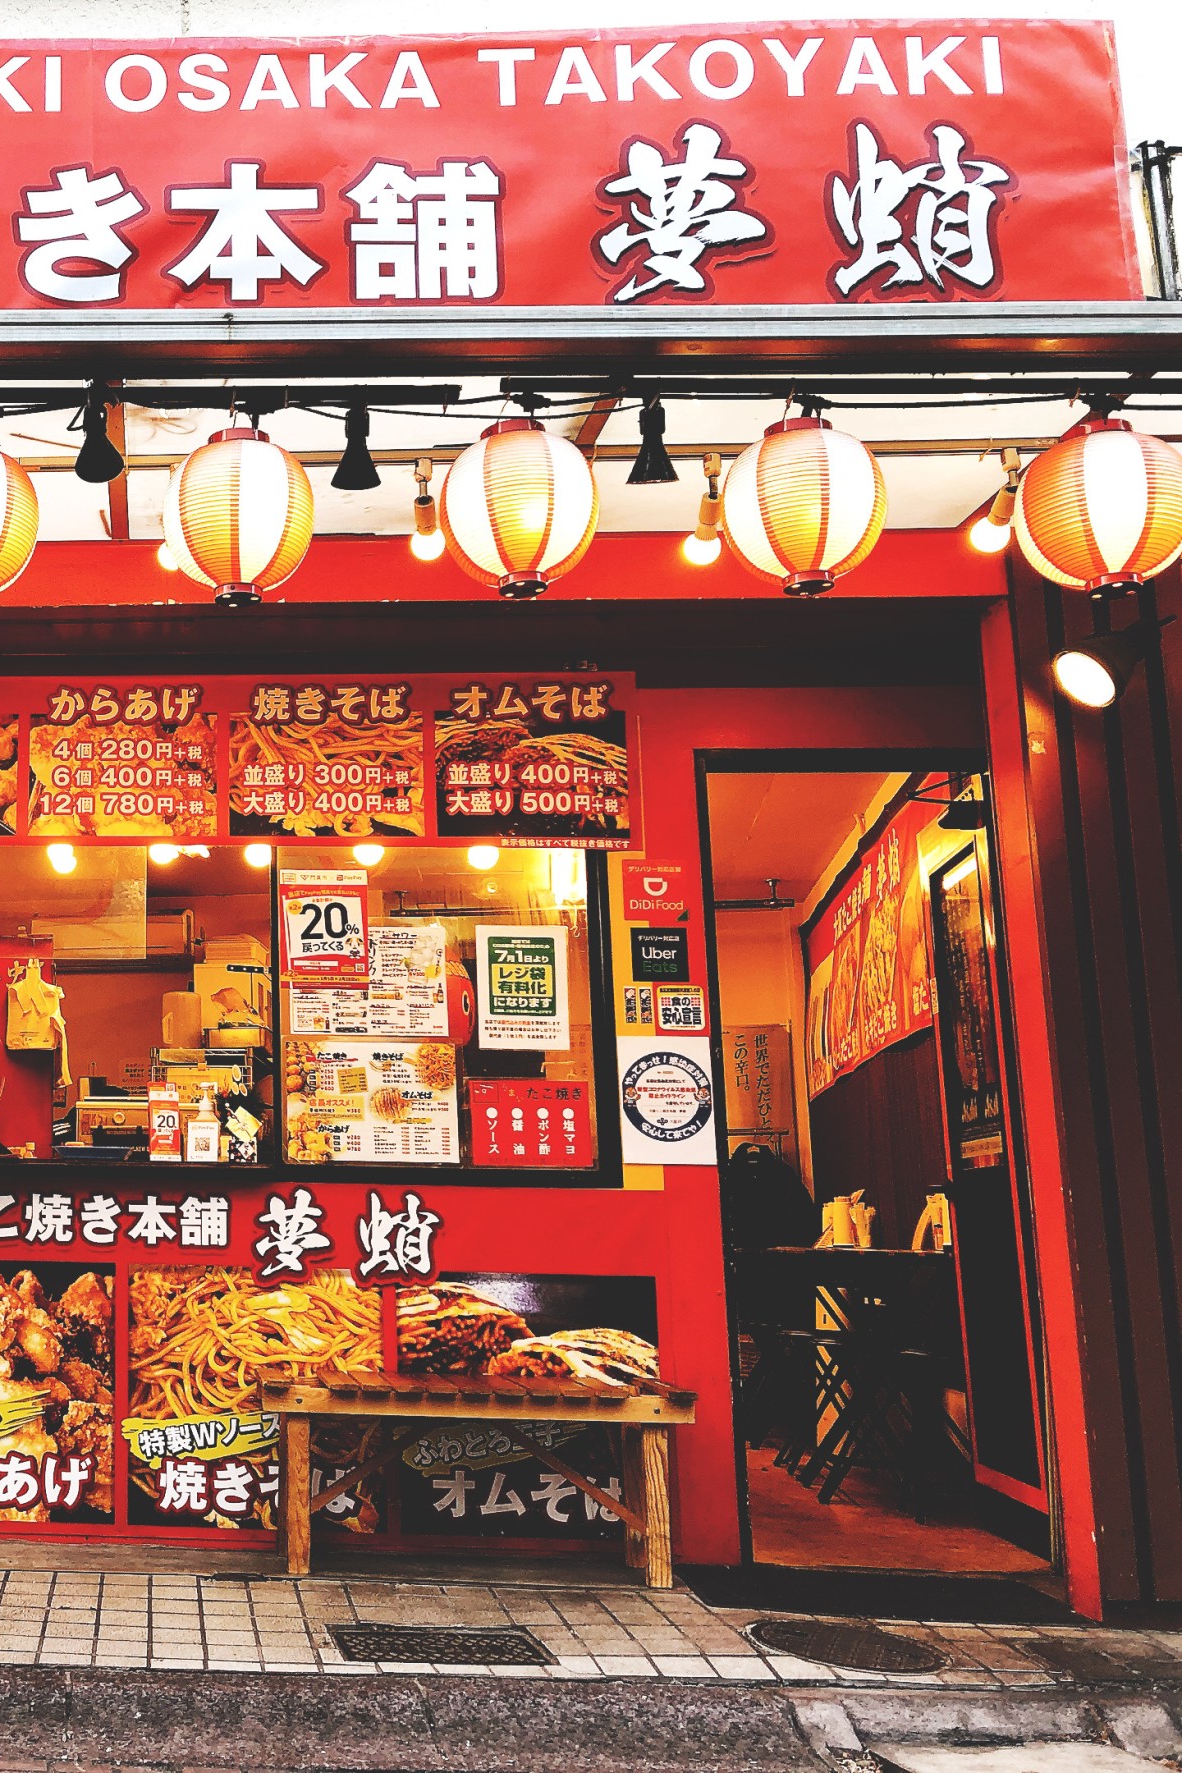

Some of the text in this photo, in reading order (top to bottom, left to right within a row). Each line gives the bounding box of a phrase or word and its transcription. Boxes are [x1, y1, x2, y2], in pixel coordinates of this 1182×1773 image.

[103, 50, 441, 114] OSAKA
[477, 35, 1006, 107] TAKOYAKI
[50, 686, 199, 722] からあげ
[254, 685, 408, 721] 焼きそば
[454, 684, 608, 720] オムそば
[54, 740, 93, 760] 4個
[53, 767, 93, 787] 6個
[243, 763, 305, 787] 並盛り
[448, 763, 511, 785] 並盛り
[40, 795, 94, 815] 12個
[243, 791, 305, 815] 大盛り
[448, 790, 512, 814] 大盛り
[629, 899, 684, 911] DiDi Food
[301, 940, 345, 953] 戻ってくる
[494, 949, 549, 963] 7月1日より
[641, 947, 677, 960] Uber
[499, 966, 546, 980] レジ袋
[642, 960, 678, 973] Eats
[498, 981, 547, 994] 有料化
[493, 996, 552, 1008] になります
[661, 1007, 702, 1025] 安心宣言
[734, 1034, 751, 1091] この辛口。
[401, 1090, 434, 1100] オムそば
[526, 1087, 582, 1101] たこ焼き
[318, 1124, 351, 1133] からあげ
[486, 1120, 500, 1154] ソース
[562, 1119, 576, 1154] 塩マヨ
